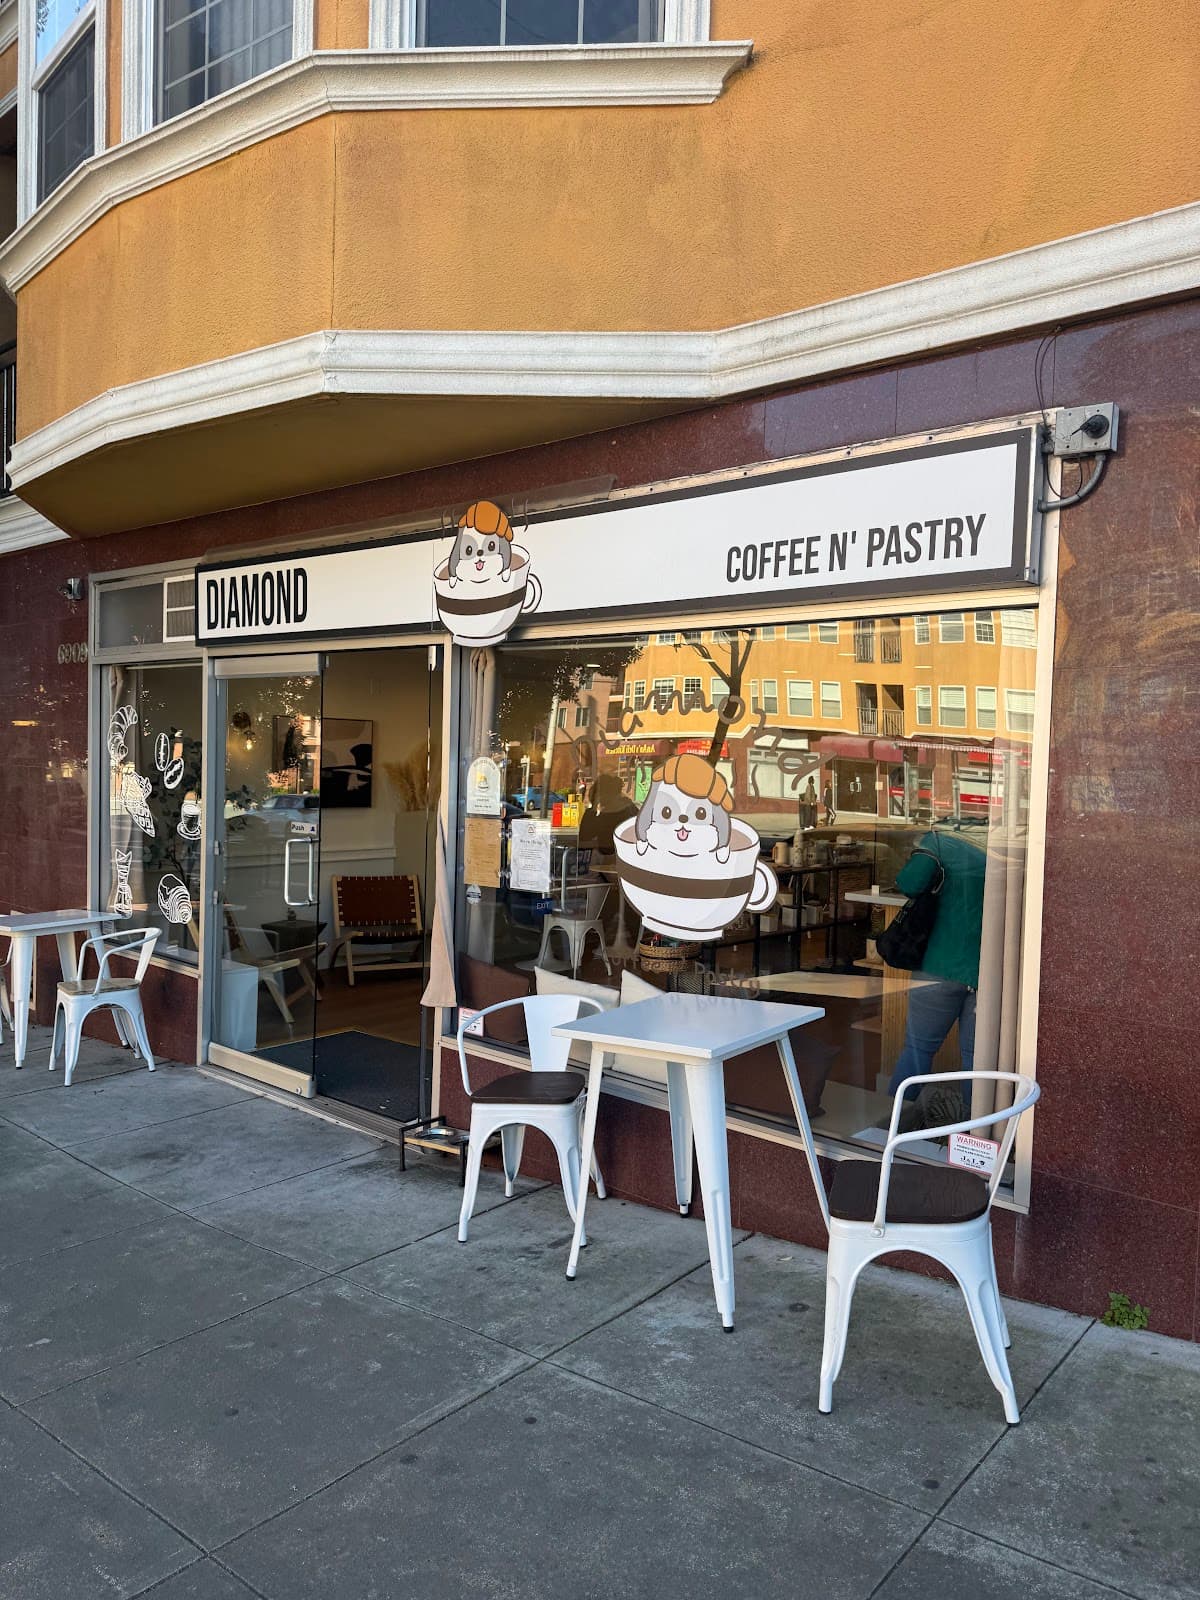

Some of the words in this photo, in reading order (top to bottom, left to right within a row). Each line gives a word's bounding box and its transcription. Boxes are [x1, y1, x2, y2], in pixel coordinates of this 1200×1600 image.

[726, 535, 821, 583] COFFEE
[828, 530, 857, 572] N'
[866, 513, 987, 568] PASTRY
[206, 567, 308, 630] DIAMOND
[291, 823, 305, 831] Push
[536, 902, 550, 910] EXIT
[956, 1135, 992, 1150] WARNING
